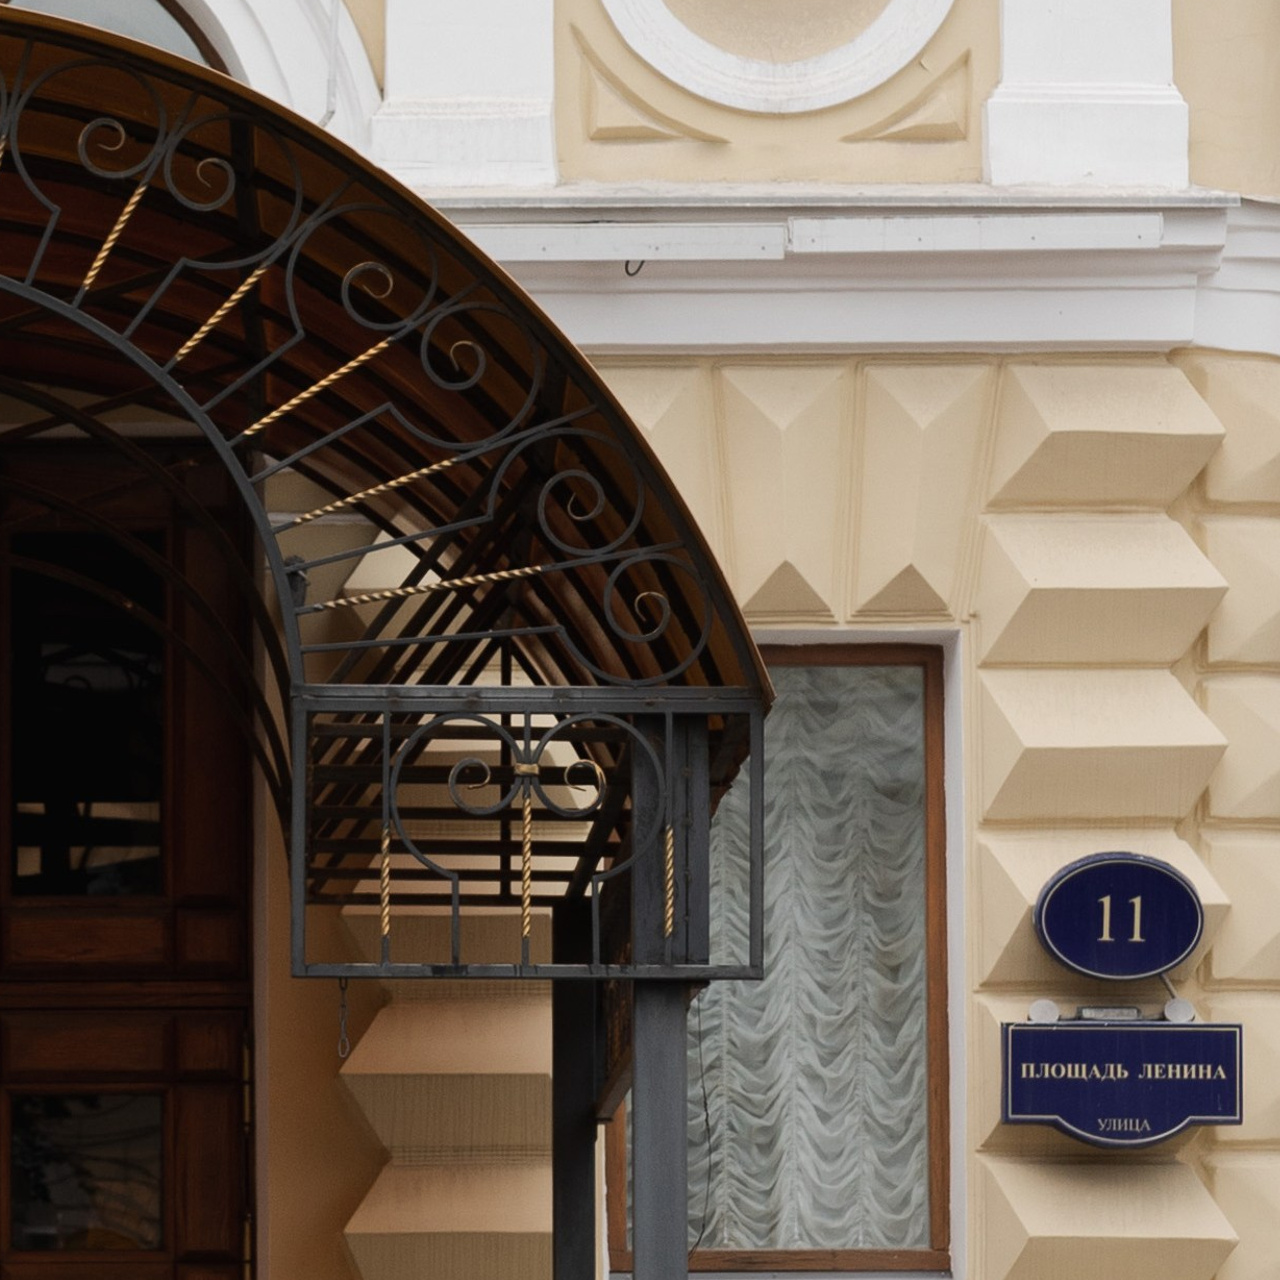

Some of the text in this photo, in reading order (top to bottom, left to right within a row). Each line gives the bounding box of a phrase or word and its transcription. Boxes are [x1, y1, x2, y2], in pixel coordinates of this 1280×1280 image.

[1097, 895, 1145, 942] 11
[1021, 1063, 1227, 1081] ПЛОЩАДЬ ЛЕНИНА
[1097, 1118, 1151, 1132] УЛИЦА
